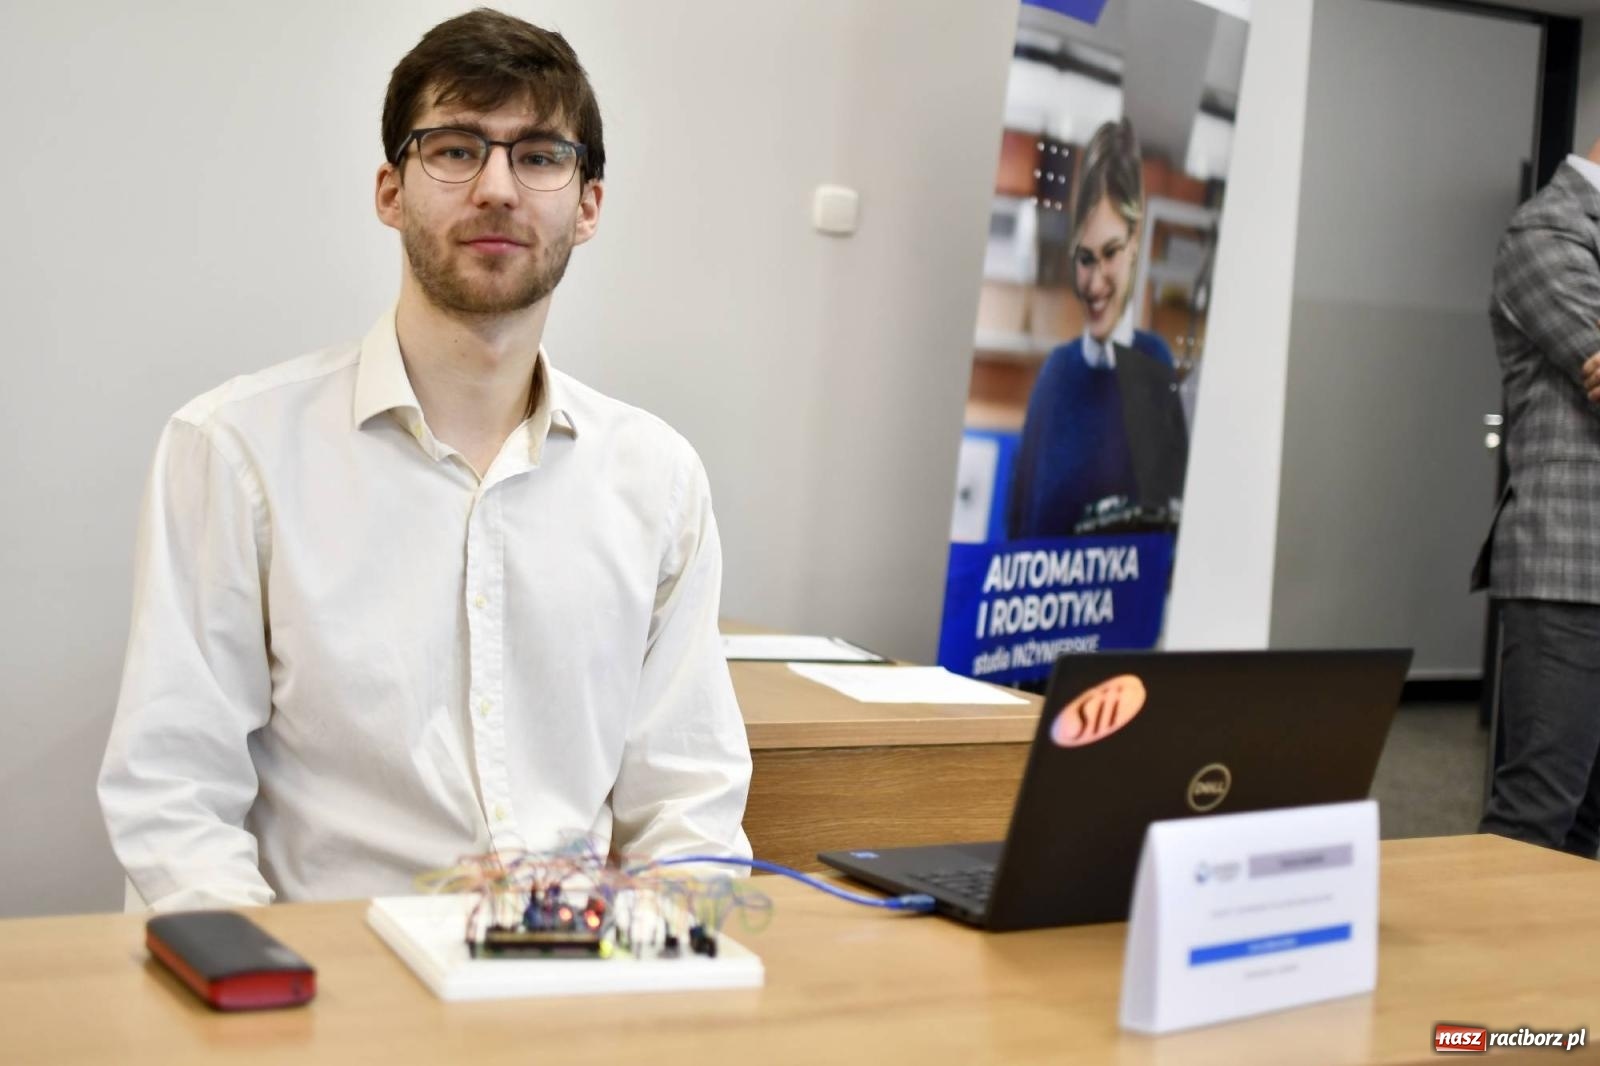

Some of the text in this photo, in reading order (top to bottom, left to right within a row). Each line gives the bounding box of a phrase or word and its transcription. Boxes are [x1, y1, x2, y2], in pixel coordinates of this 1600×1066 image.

[983, 546, 1139, 594] AUTOMATYKA
[976, 588, 1114, 639] I ROBOTYKA
[1195, 781, 1225, 795] DELL
